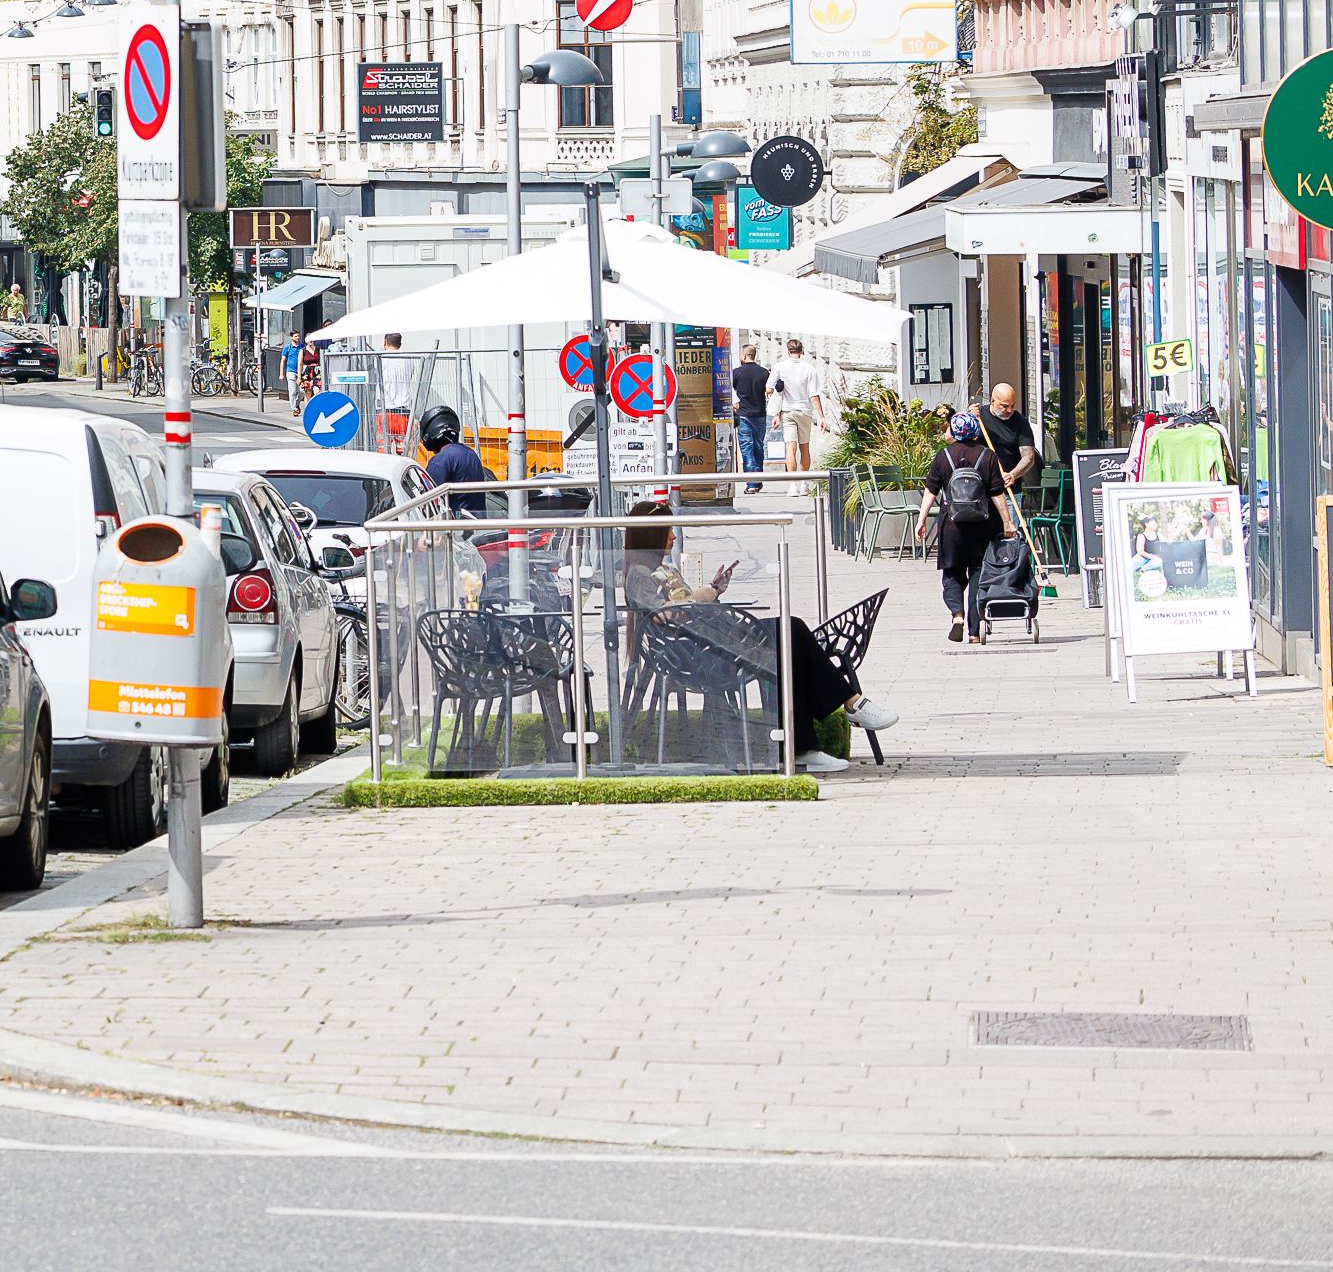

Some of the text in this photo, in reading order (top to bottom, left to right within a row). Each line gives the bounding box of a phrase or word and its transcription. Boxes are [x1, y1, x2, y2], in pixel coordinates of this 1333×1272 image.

[362, 105, 439, 115] No1 HAIRSTYLIST
[801, 148, 814, 162] UND
[1297, 173, 1333, 197] KA
[744, 199, 765, 210] vom
[751, 205, 782, 220] FASS
[250, 211, 296, 241] HR
[676, 351, 712, 364] IEDER
[1153, 342, 1188, 370] 5€
[623, 464, 653, 473] Anfan
[23, 628, 81, 636] ENAULT
